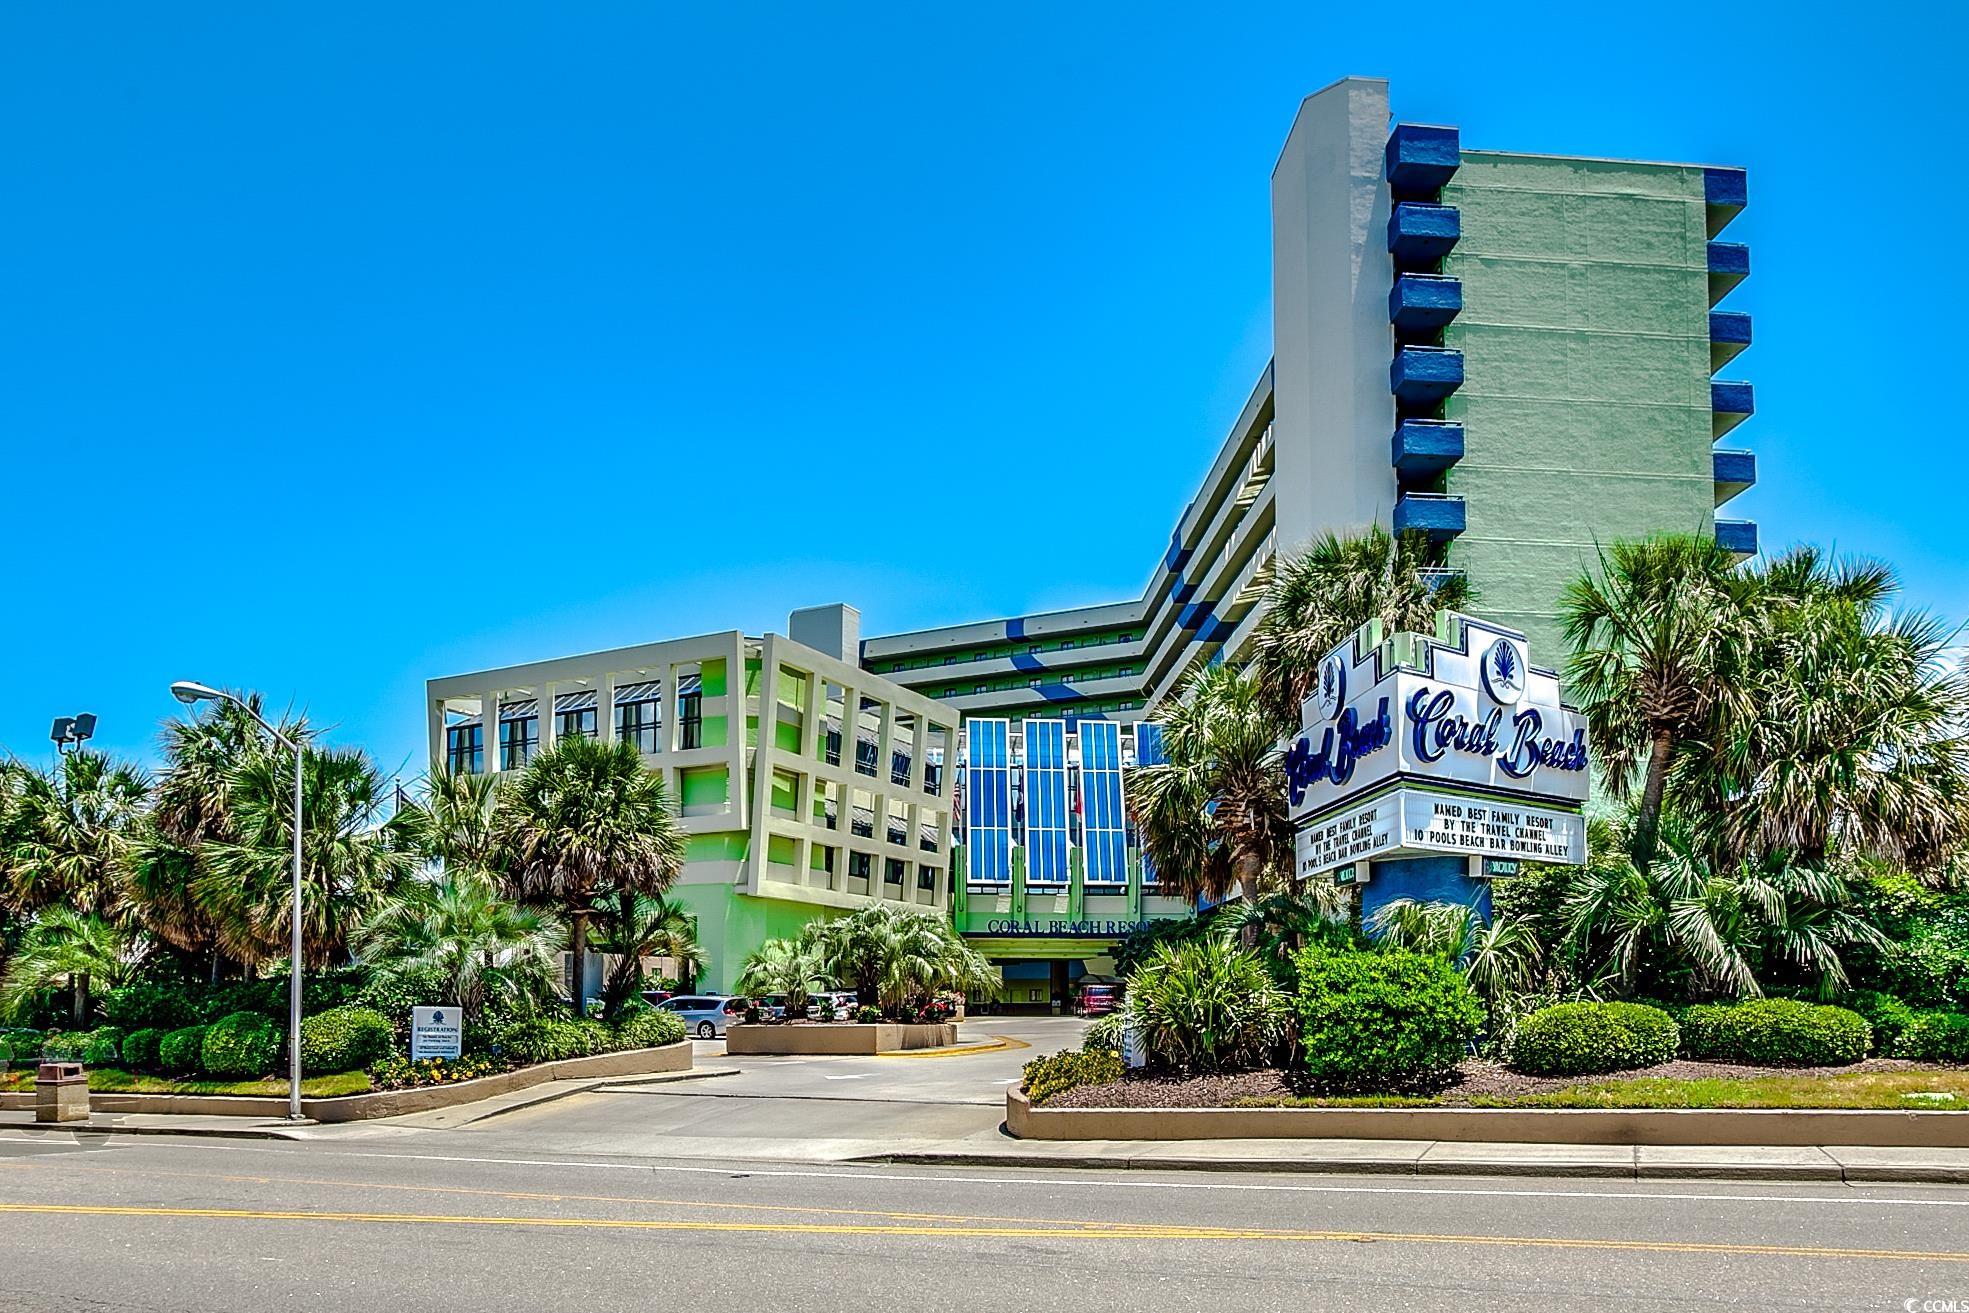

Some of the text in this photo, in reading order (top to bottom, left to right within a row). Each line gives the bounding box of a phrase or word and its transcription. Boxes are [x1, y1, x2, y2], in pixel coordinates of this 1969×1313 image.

[1406, 687, 1588, 778] Coral Beach
[1326, 825, 1338, 838] BEST
[1340, 817, 1356, 833] FAMILY
[1359, 809, 1378, 826] RESORT
[1434, 803, 1553, 830] NAMED BEST FAMILY RESORT
[1444, 819, 1546, 841] BY THE TRAVEL CHANNEL
[1323, 841, 1331, 852] THE
[1333, 833, 1350, 849] TRAVEL
[1323, 851, 1336, 865] BEACH
[1338, 847, 1348, 860] BAR
[1350, 839, 1371, 856] BOWLING
[1373, 832, 1389, 848] ALLEY
[1414, 829, 1568, 857] 10 POOLS BEACH BAR BOWLING ALLEY
[988, 919, 1150, 934] CORAL BEACH RESO
